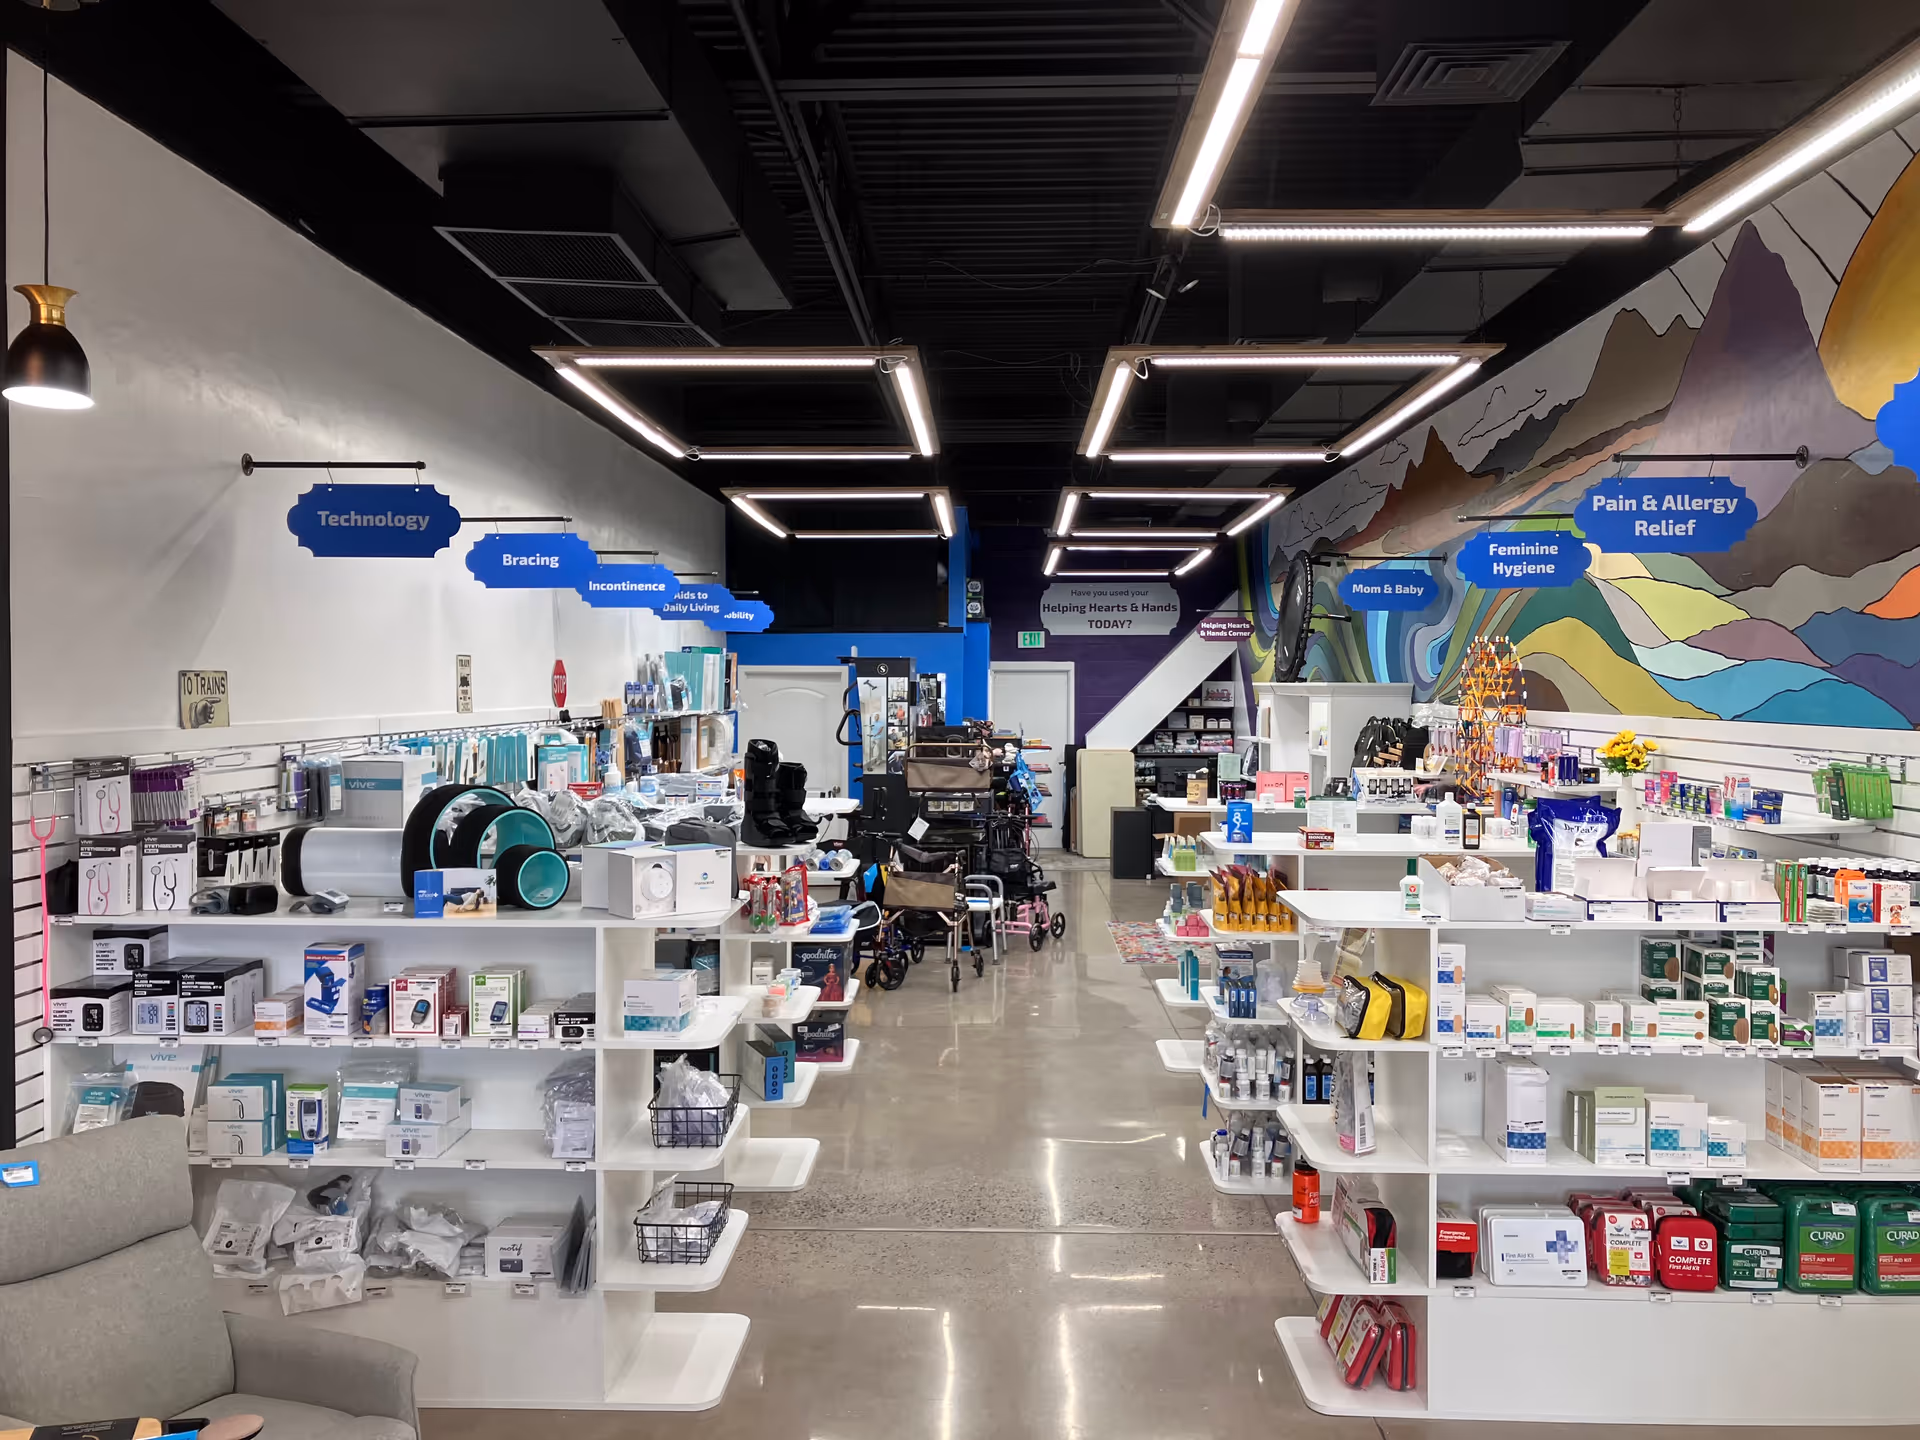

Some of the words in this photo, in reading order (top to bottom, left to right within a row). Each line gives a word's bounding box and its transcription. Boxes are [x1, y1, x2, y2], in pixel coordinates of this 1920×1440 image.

[1592, 495, 1637, 511] Pain
[1641, 495, 1658, 511] &
[1662, 495, 1738, 515] Allergy
[317, 510, 429, 531] Technology
[1634, 520, 1696, 536] Relief
[1489, 543, 1559, 556] Feminine
[502, 553, 559, 570] Bracing
[1493, 562, 1555, 577] Hygiene
[588, 581, 666, 592] Incontinence
[1352, 583, 1381, 595] Mom
[1383, 584, 1394, 595] &
[1396, 583, 1424, 597] Baby
[674, 591, 696, 599] Aids
[697, 591, 708, 599] to
[1071, 589, 1092, 597] Have
[1093, 590, 1108, 598] you
[1109, 589, 1130, 597] used
[1131, 590, 1149, 598] your
[663, 603, 688, 613] Daily
[690, 603, 720, 613] Living
[1042, 603, 1086, 614] Helping
[1089, 603, 1128, 613] Hearts
[1130, 603, 1139, 612] &
[1141, 603, 1178, 612] Hands
[724, 611, 754, 621] obility
[1088, 619, 1132, 629] TODAY?
[1201, 622, 1226, 630] Helping
[1022, 632, 1041, 646] EXIT
[553, 675, 567, 693] STOP
[801, 948, 837, 962] goodnites
[150, 1051, 177, 1061] vive
[1810, 1231, 1845, 1241] CURAD
[1886, 1231, 1920, 1241] CURAD
[1744, 1249, 1768, 1257] CURAD
[1669, 1256, 1711, 1265] COMPLETE
